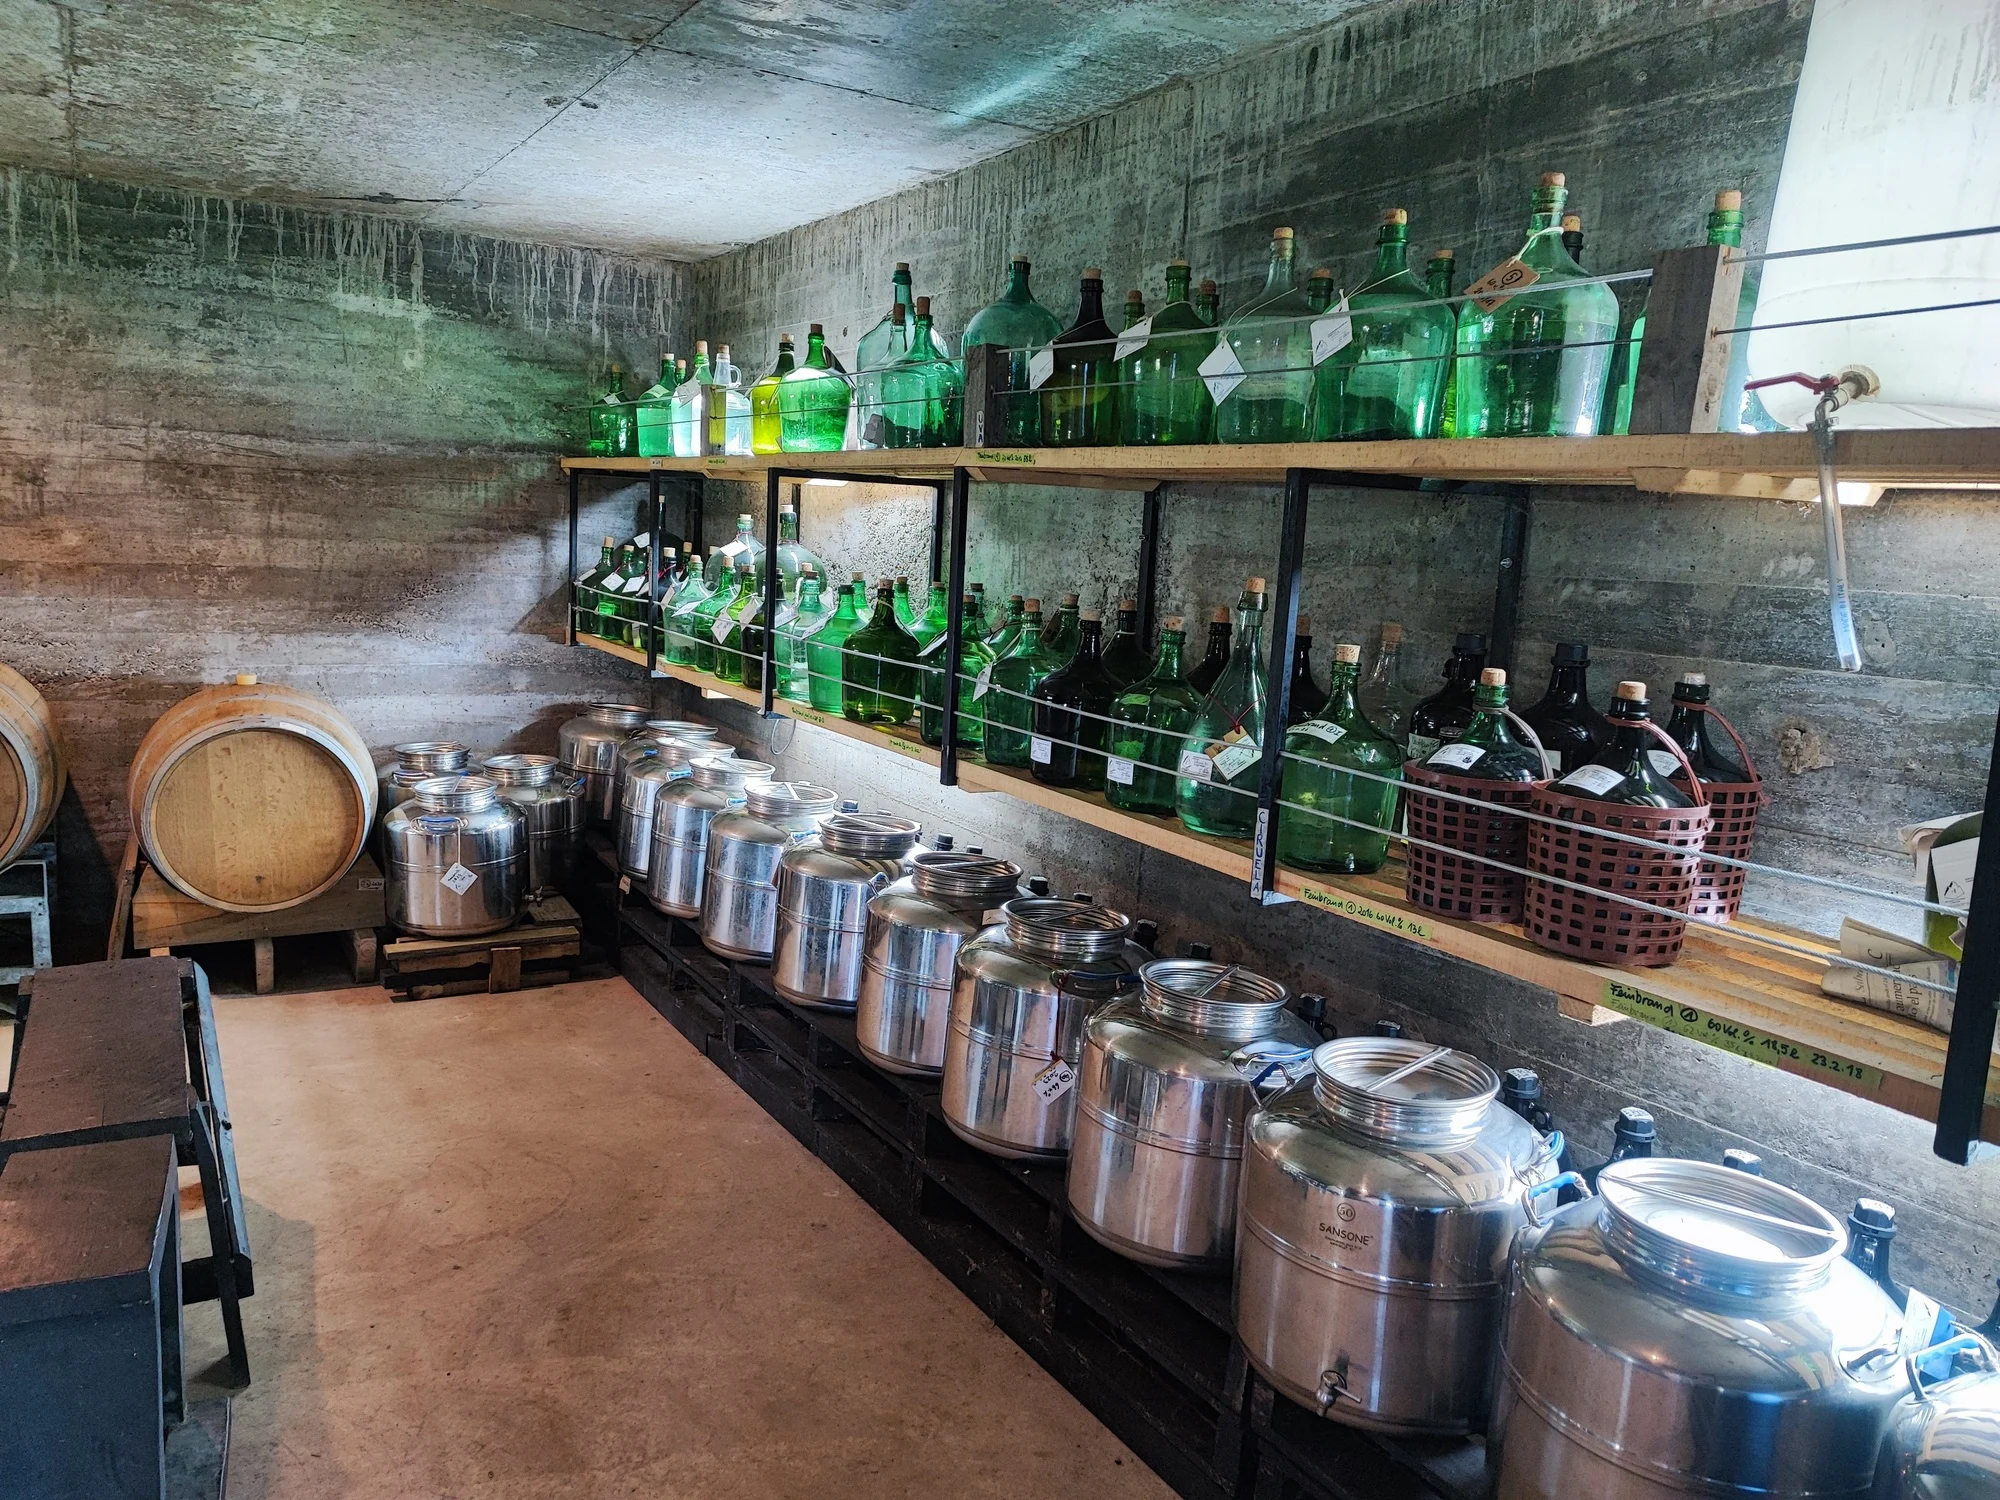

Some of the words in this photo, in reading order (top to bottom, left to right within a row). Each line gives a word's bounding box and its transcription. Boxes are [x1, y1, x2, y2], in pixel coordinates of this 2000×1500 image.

[1253, 811, 1266, 893] CIRUELA
[1304, 888, 1343, 909] Feinbrand
[1357, 905, 1374, 919] 2016
[1909, 974, 1923, 996] pas
[1907, 995, 1920, 1006] el
[1610, 983, 1674, 1016] Feinbrand
[1707, 1018, 1722, 1031] 60
[1811, 1053, 1863, 1080] 23.2.18
[1319, 1222, 1370, 1246] SANSONE
